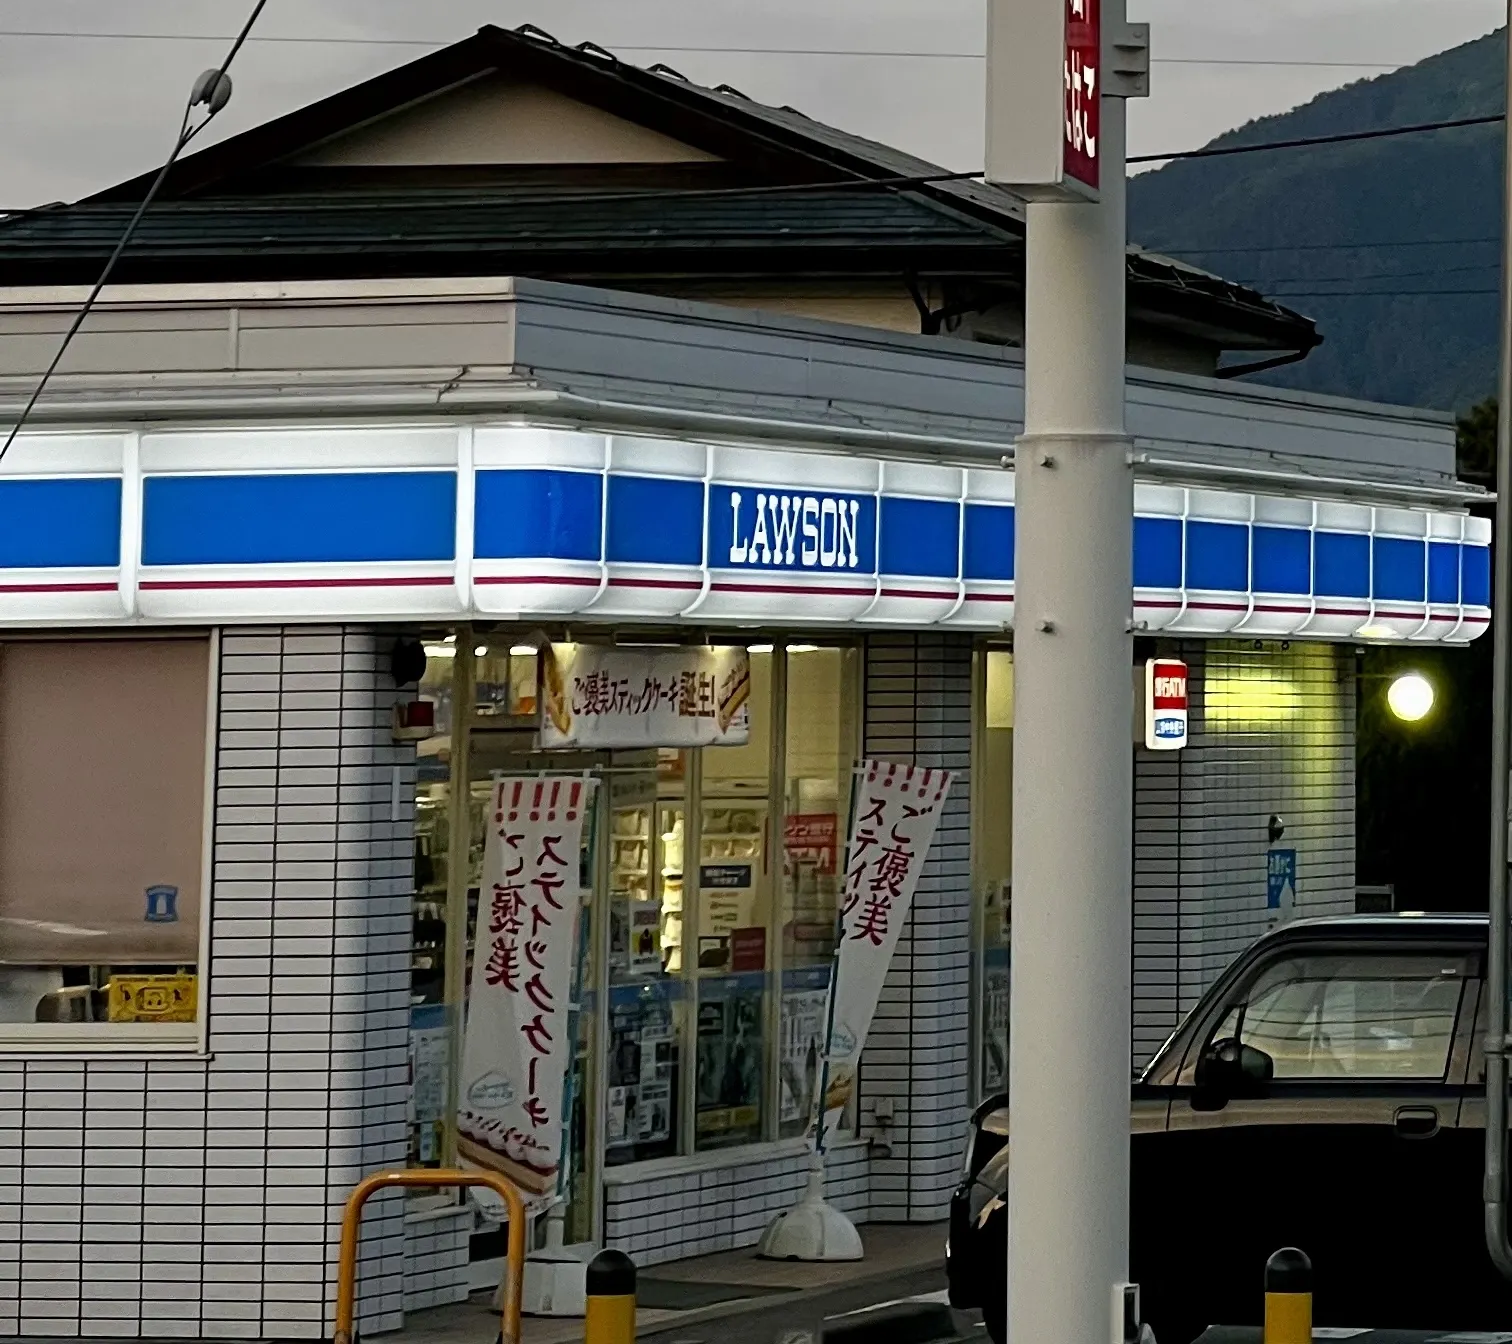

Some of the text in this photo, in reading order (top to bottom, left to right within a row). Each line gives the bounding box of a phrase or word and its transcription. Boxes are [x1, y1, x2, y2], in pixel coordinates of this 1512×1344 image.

[729, 491, 860, 568] LAWSON
[849, 803, 933, 946] ご褒美
